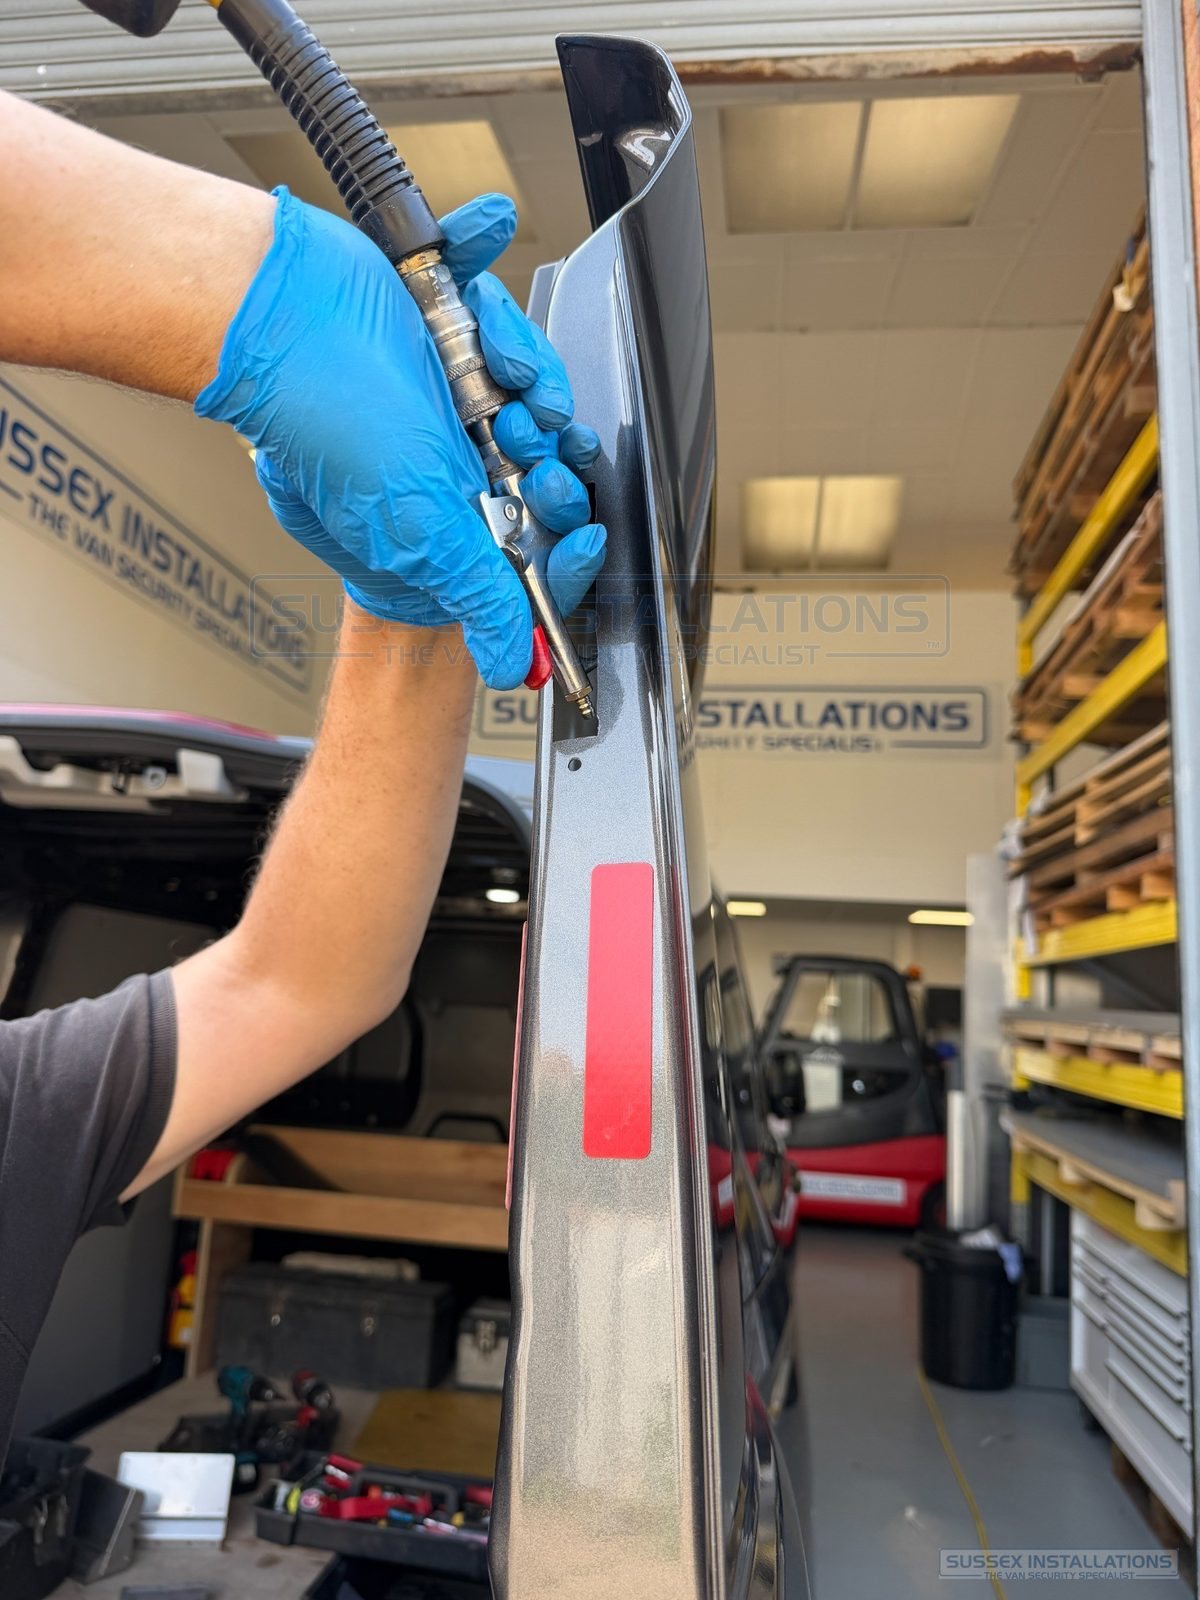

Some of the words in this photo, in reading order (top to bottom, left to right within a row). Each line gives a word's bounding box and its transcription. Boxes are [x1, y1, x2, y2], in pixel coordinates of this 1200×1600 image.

[27, 491, 70, 540] THE
[72, 520, 114, 570] VAN
[119, 503, 307, 671] INSTALLATIONS
[697, 700, 970, 731] STALLATIONS
